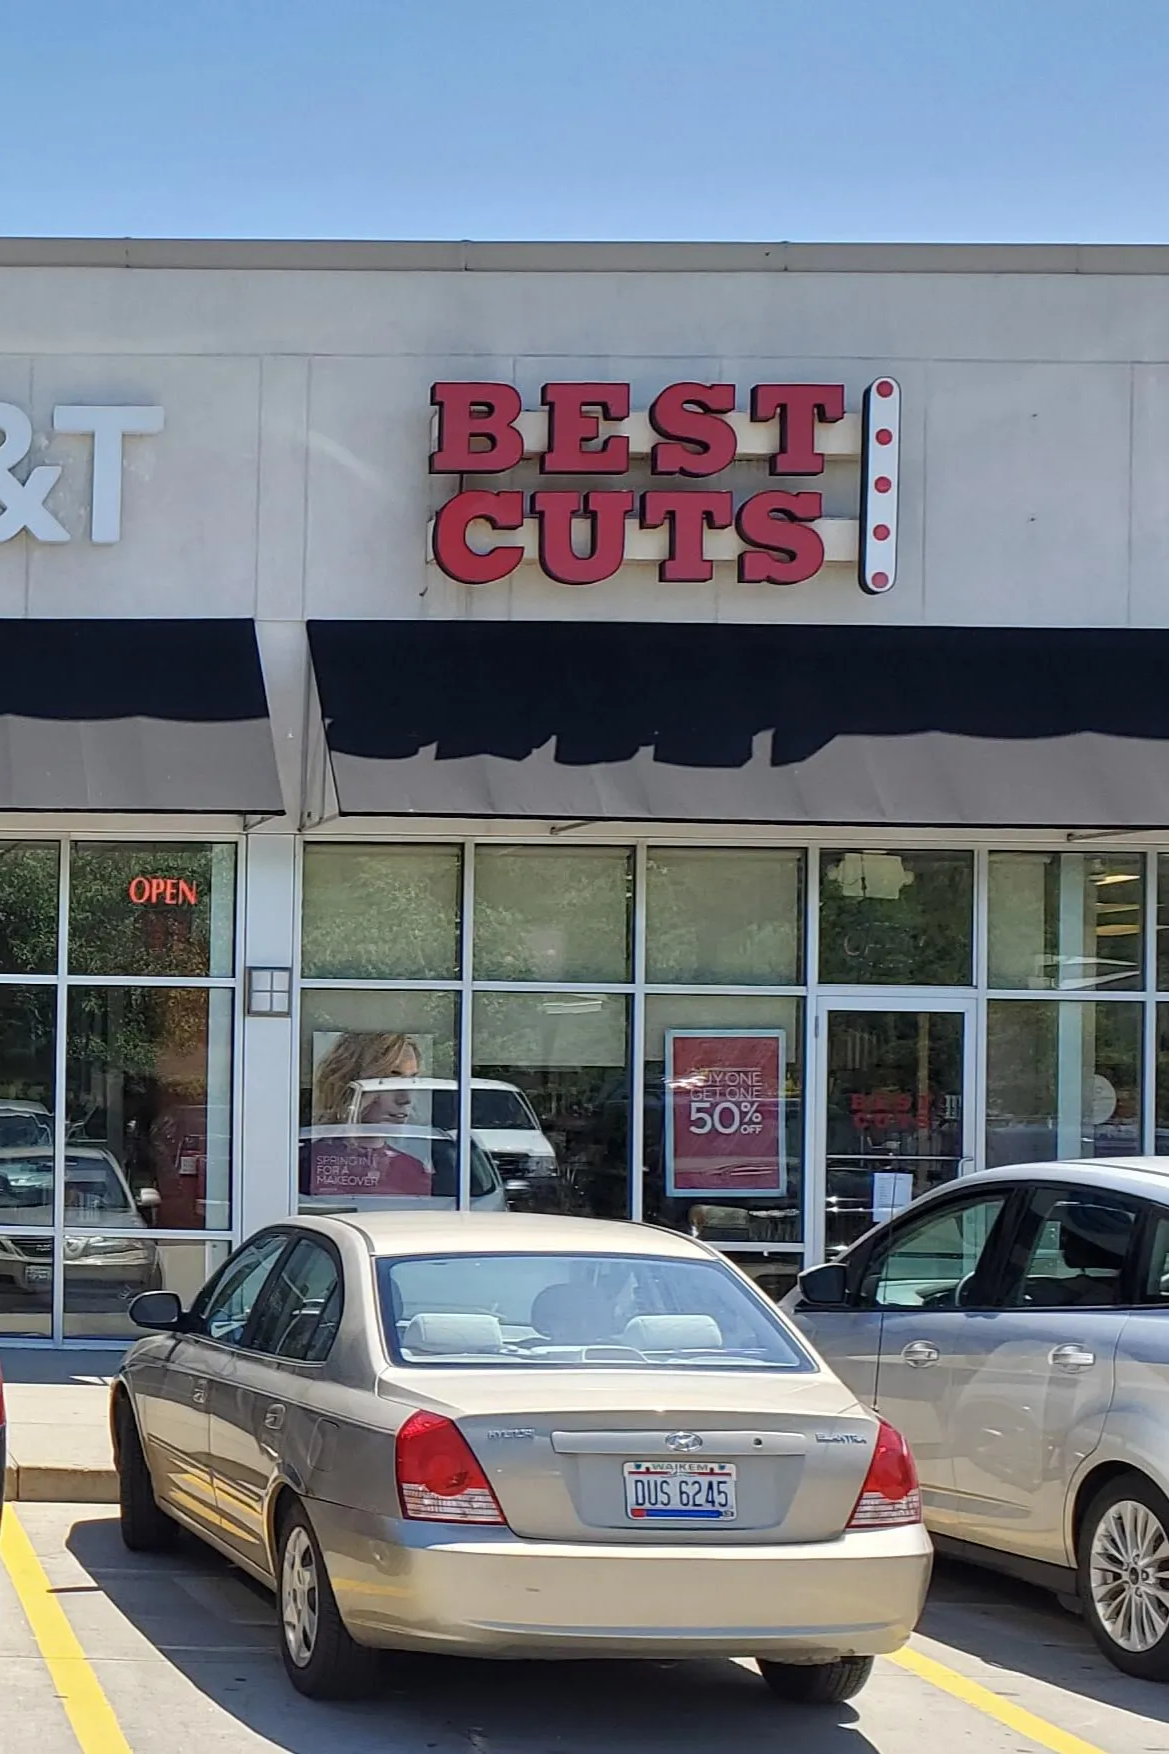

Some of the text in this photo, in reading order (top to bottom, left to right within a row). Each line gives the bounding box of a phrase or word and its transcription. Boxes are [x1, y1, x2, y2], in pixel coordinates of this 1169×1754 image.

[429, 382, 845, 477] BEST
[433, 490, 825, 585] CUTS
[128, 876, 197, 905] OPEN
[725, 1071, 764, 1086] ONE
[690, 1086, 764, 1101] GET ONE
[689, 1101, 763, 1135] 50%
[740, 1124, 763, 1135] OFF
[316, 1155, 357, 1166] SPRING
[316, 1165, 350, 1175] FOR A
[316, 1175, 379, 1186] MAKEOVER
[652, 1463, 709, 1472] WAIKEM
[634, 1479, 729, 1508] DUS 6245
